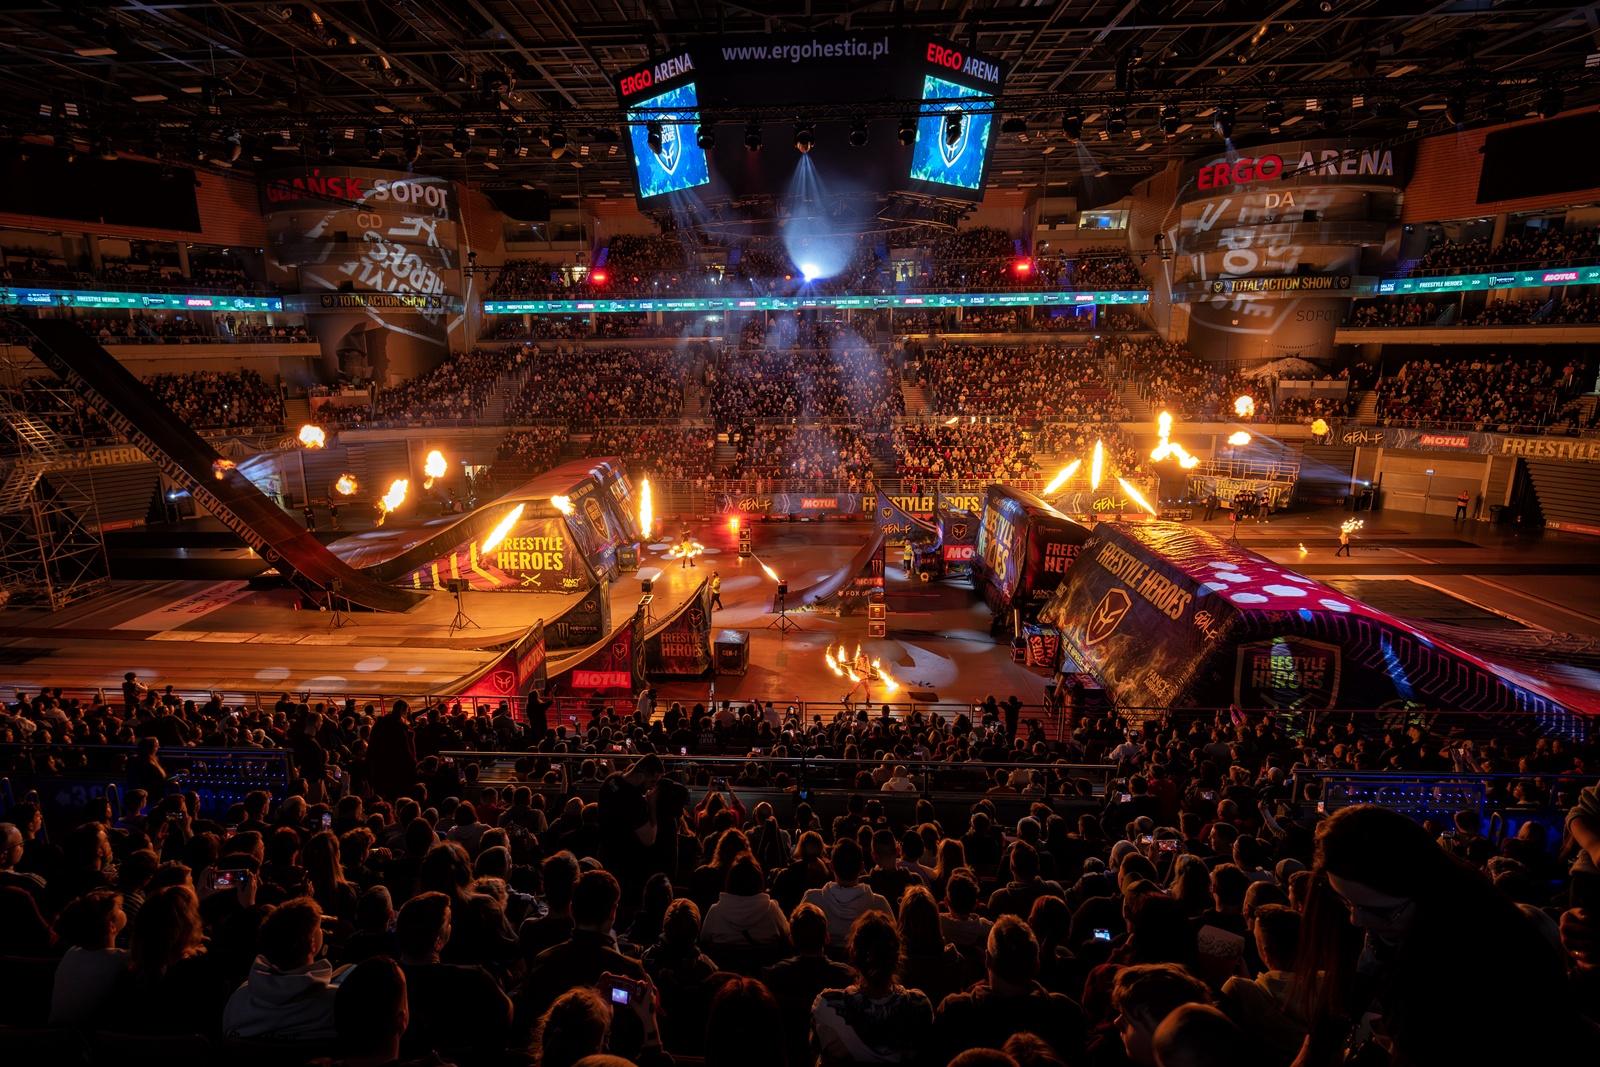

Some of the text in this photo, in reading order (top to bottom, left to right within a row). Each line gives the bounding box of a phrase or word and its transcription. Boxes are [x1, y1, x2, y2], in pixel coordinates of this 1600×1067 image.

[722, 37, 889, 63] www.ergohestia.pl
[927, 42, 999, 84] ERGO ARENA
[620, 52, 694, 96] ERGO ARENA
[1197, 149, 1394, 191] ERGO ARENA
[266, 169, 448, 209] GDAŃSK SOPOT
[1265, 192, 1296, 209] DA
[356, 213, 383, 229] CD
[1231, 276, 1333, 292] TOTAL ACTION SHOW
[1419, 280, 1444, 288] FREESTYLE
[1544, 272, 1576, 281] MOTUL
[339, 295, 426, 307] TOTAL ACTION SHOW
[279, 436, 306, 451] GEN
[1342, 431, 1384, 444] GEN-F
[1423, 436, 1466, 447] MOTUL
[65, 368, 264, 551] WE ARE THE FREESTYLE GENERATION
[1215, 479, 1258, 491] FREESTYLE
[738, 499, 773, 512] GEN-F
[803, 499, 836, 509] MOTUL
[1092, 496, 1129, 511] GEN-F
[881, 522, 911, 536] GEN-F
[496, 536, 564, 551] FREESTYLE
[1046, 542, 1081, 557] FREES
[497, 551, 564, 571] HEROES
[1044, 555, 1075, 574] HER
[1095, 541, 1193, 621] FREESTYLE HEROES
[1194, 609, 1219, 641] GEN-F
[660, 632, 703, 643] FREESTYLE
[661, 643, 703, 657] HEROES
[519, 641, 546, 683] MOTUL
[1252, 655, 1327, 671] FREESTYLE
[574, 673, 629, 685] MOTUL
[1251, 670, 1326, 689] HEROES
